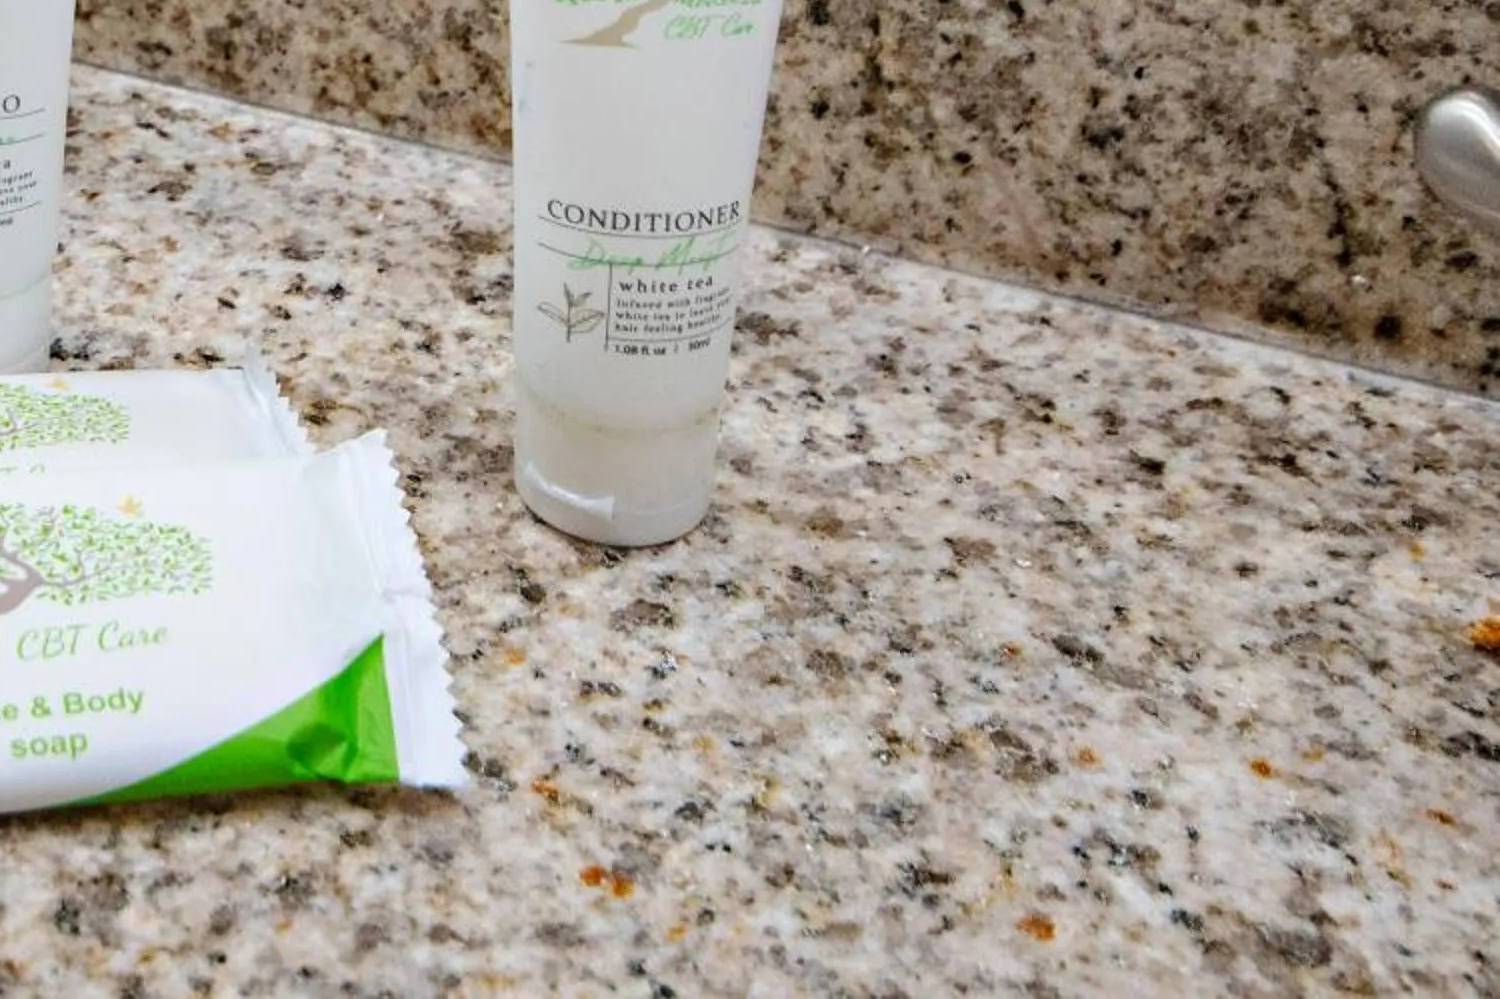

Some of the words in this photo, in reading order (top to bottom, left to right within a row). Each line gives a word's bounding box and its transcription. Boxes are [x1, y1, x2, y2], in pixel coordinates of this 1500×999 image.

[547, 198, 740, 233] CONDITIONER
[619, 279, 678, 294] white
[687, 276, 712, 290] tea
[16, 623, 88, 661] CBT
[98, 620, 168, 652] Care
[30, 696, 52, 719] &
[63, 687, 145, 715] Body
[10, 733, 89, 760] soap
